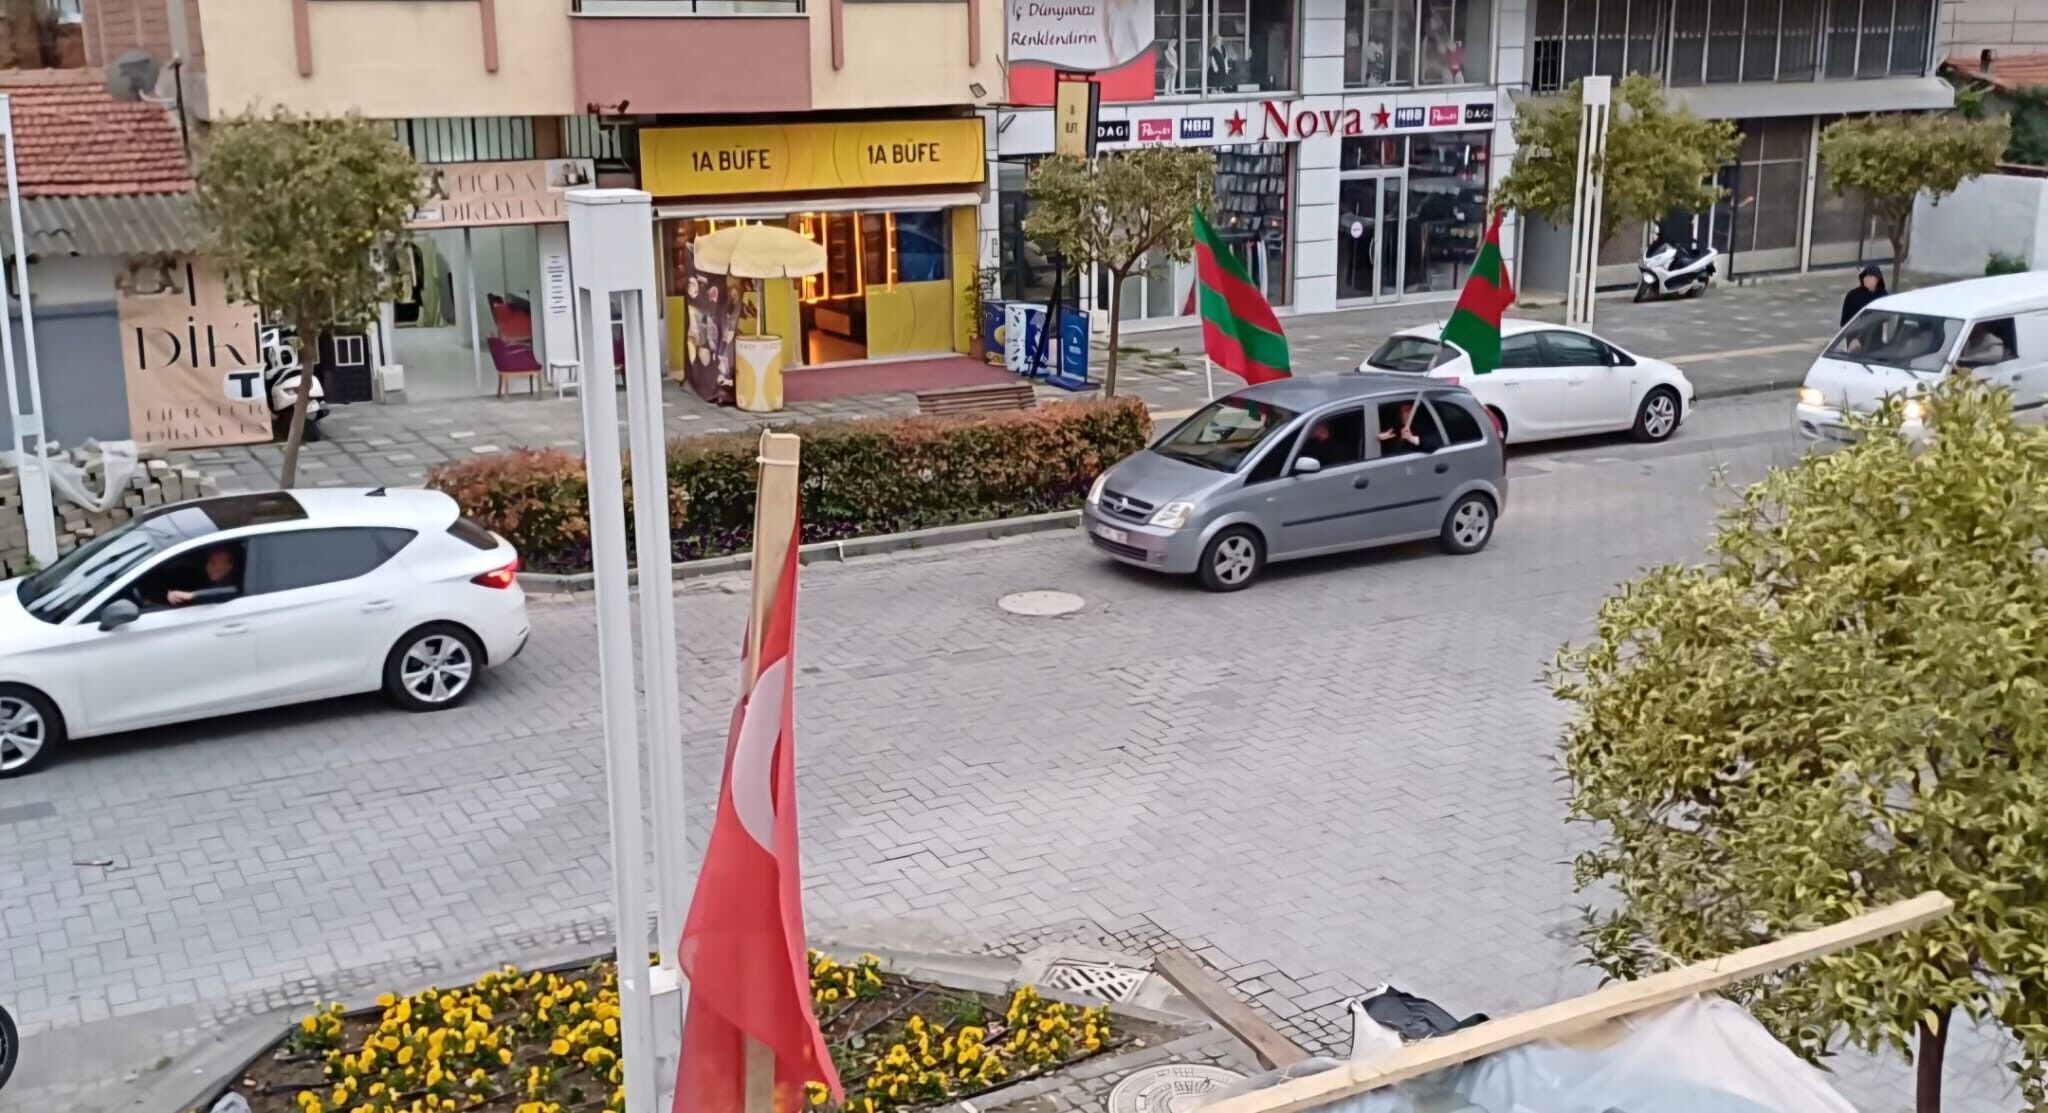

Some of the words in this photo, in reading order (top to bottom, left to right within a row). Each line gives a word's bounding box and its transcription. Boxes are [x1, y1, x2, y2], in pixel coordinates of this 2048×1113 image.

[1257, 100, 1363, 140] Nova
[692, 150, 713, 172] 1A
[719, 144, 771, 171] BÜFE
[867, 144, 887, 165] 1A
[893, 138, 940, 164] BÜFE
